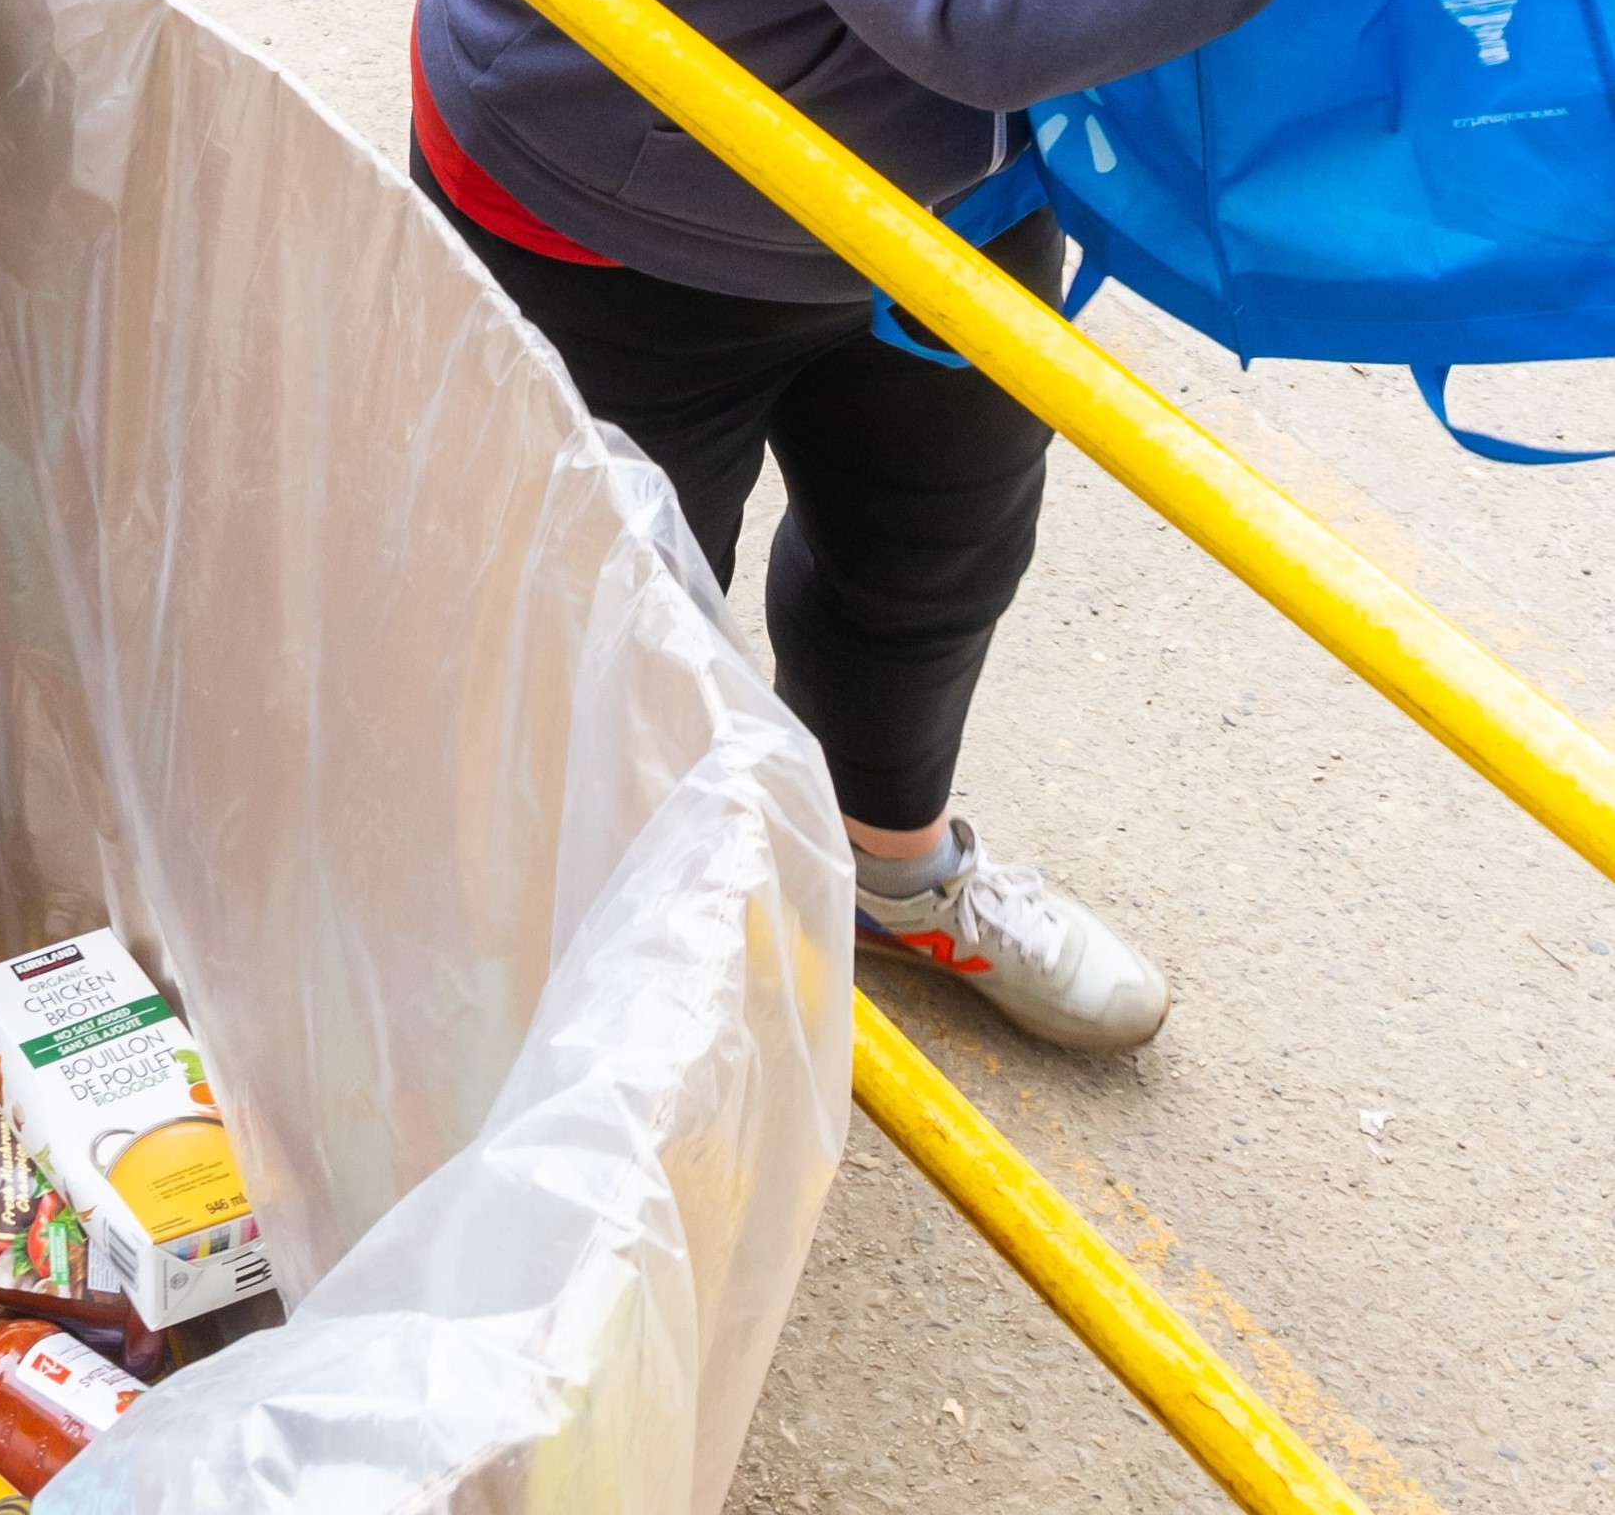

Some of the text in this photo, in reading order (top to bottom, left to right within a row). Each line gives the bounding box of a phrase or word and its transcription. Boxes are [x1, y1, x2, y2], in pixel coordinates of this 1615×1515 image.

[14, 946, 78, 974] KIRKLAND
[23, 970, 117, 1015] CHICKEN
[27, 964, 90, 994] ORGANIC
[45, 990, 117, 1028] BROTH
[53, 1007, 132, 1043] NO SALT ADDED
[57, 1037, 85, 1057] SANS
[84, 1031, 104, 1047] SEL
[59, 1029, 167, 1081] BOUILLON
[69, 1047, 181, 1102] DE POULET
[94, 1071, 172, 1108] BIOLOGIQUE
[204, 1197, 230, 1216] 946
